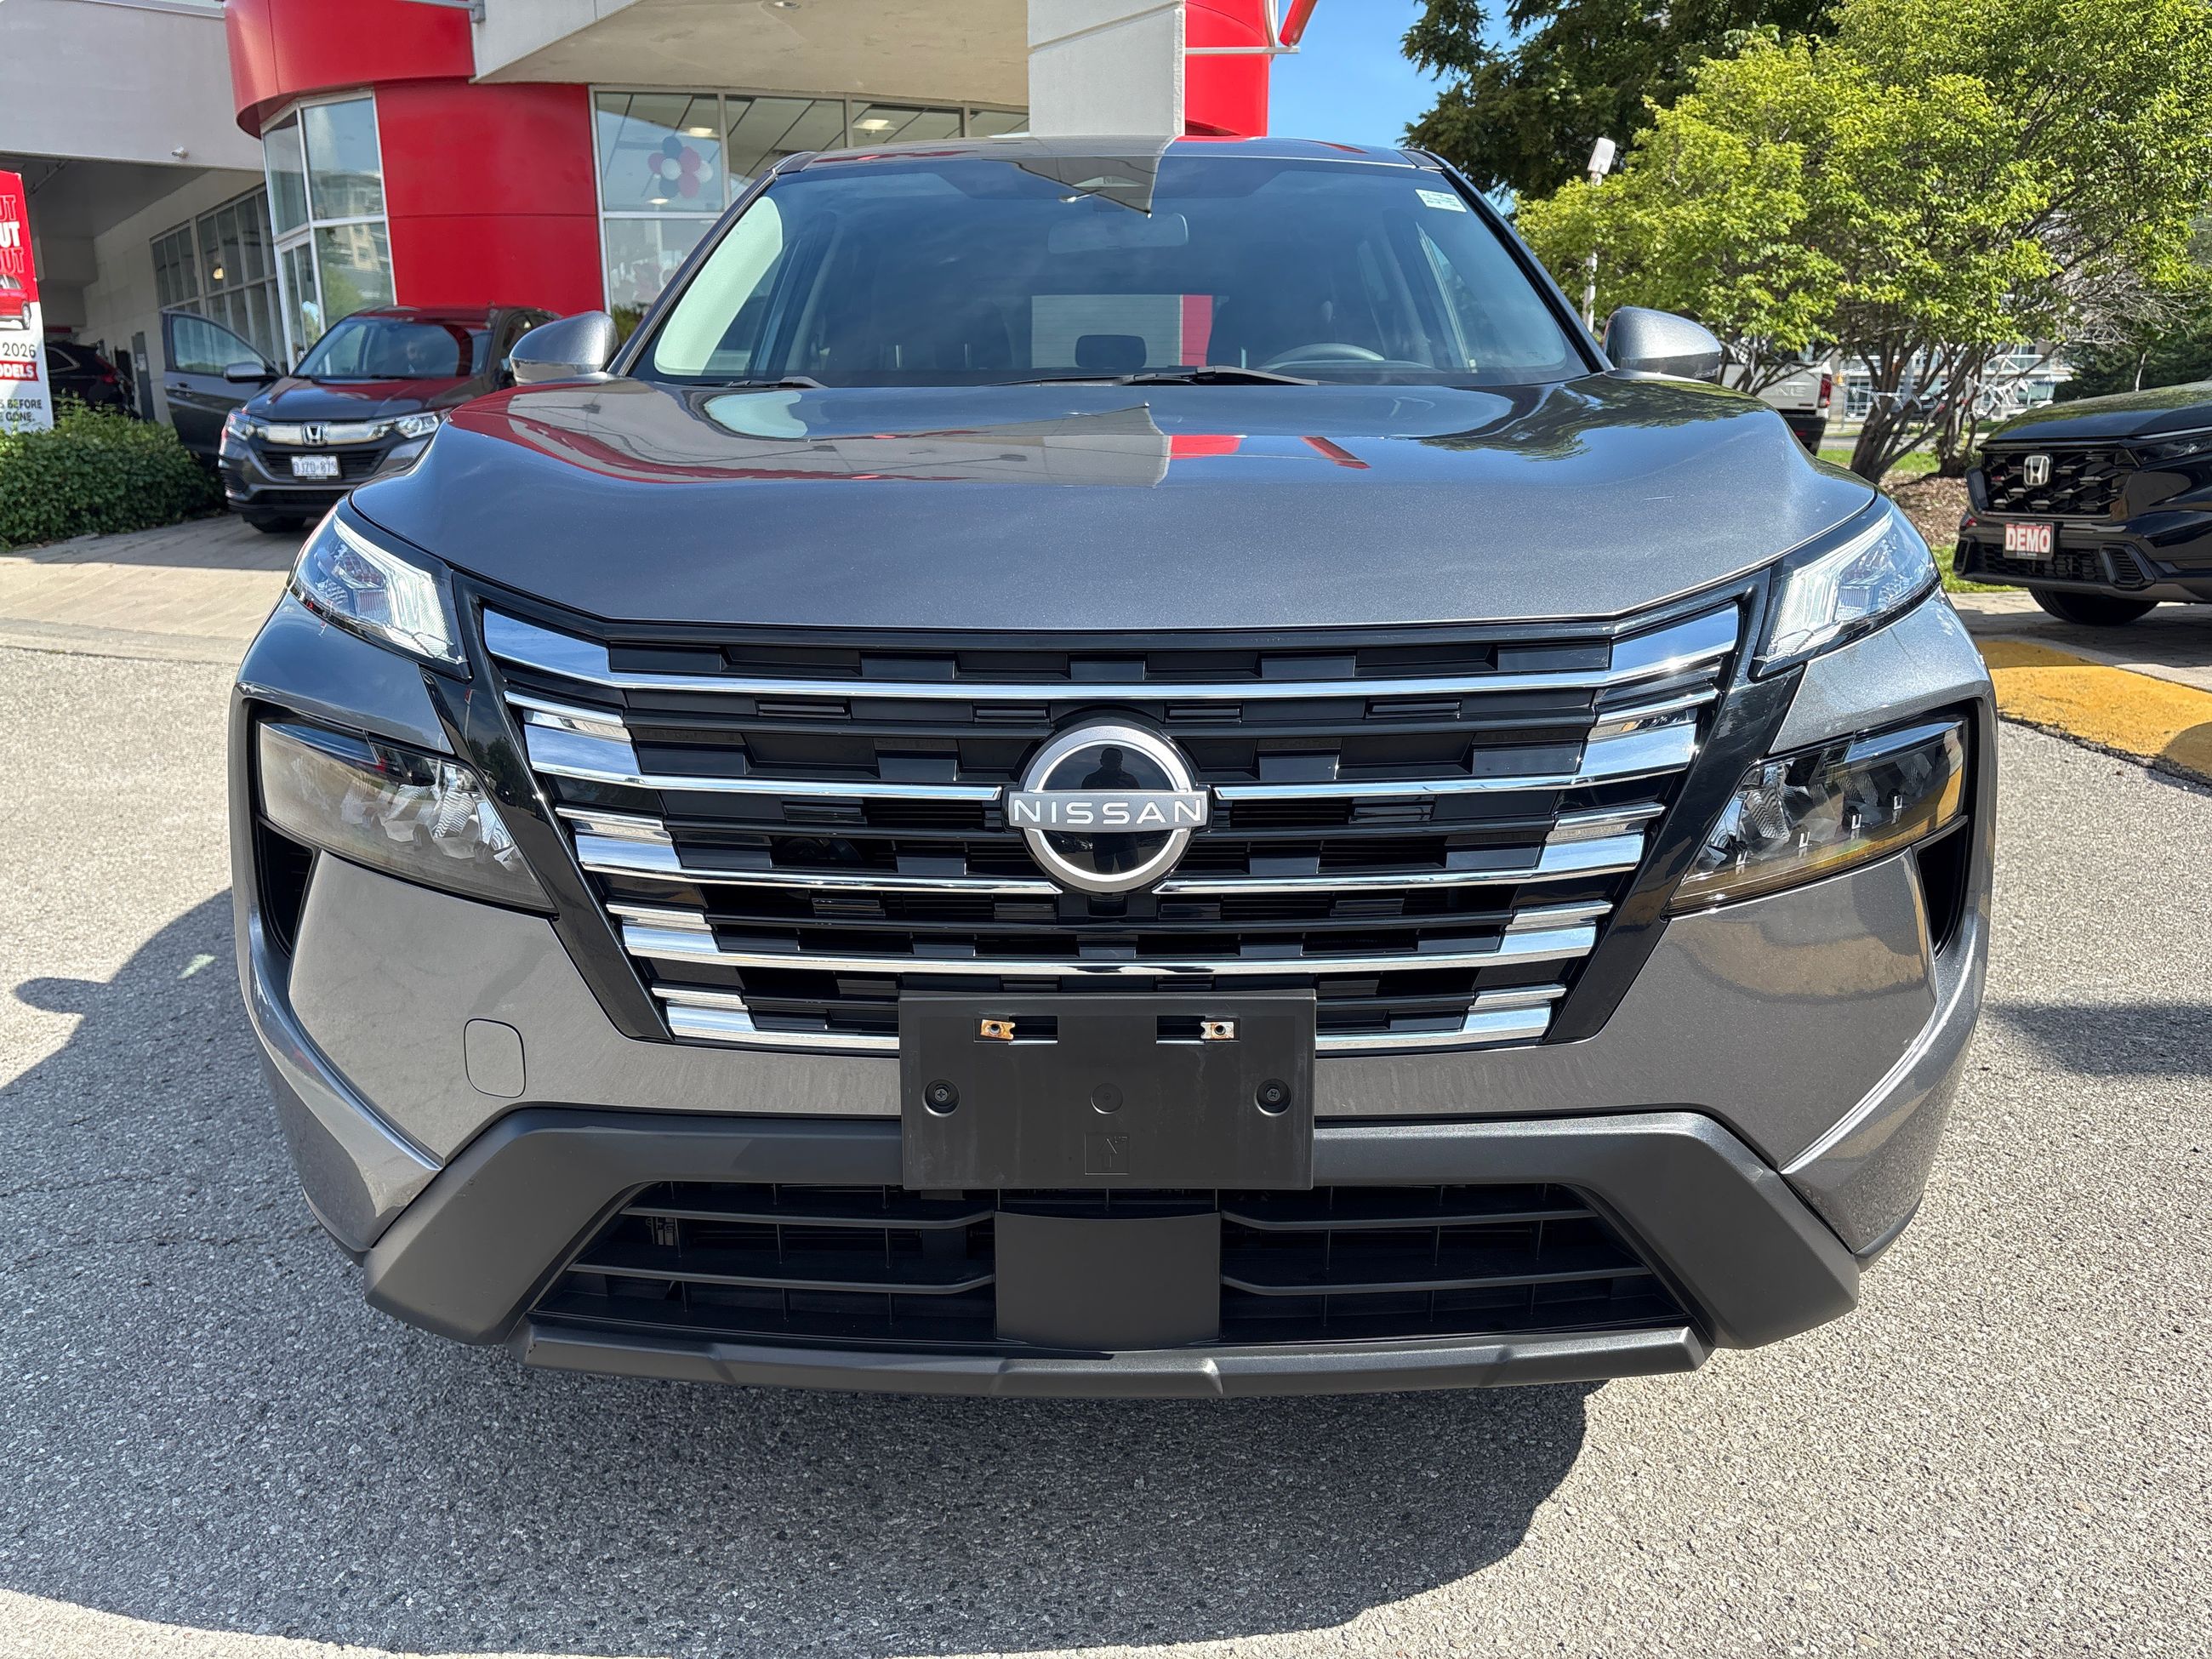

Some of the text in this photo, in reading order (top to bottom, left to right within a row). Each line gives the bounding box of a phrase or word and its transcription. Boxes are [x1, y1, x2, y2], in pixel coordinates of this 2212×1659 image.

[3, 342, 37, 358] 2026
[2005, 527, 2050, 553] DEMO
[1013, 798, 1201, 824] NISSAN
